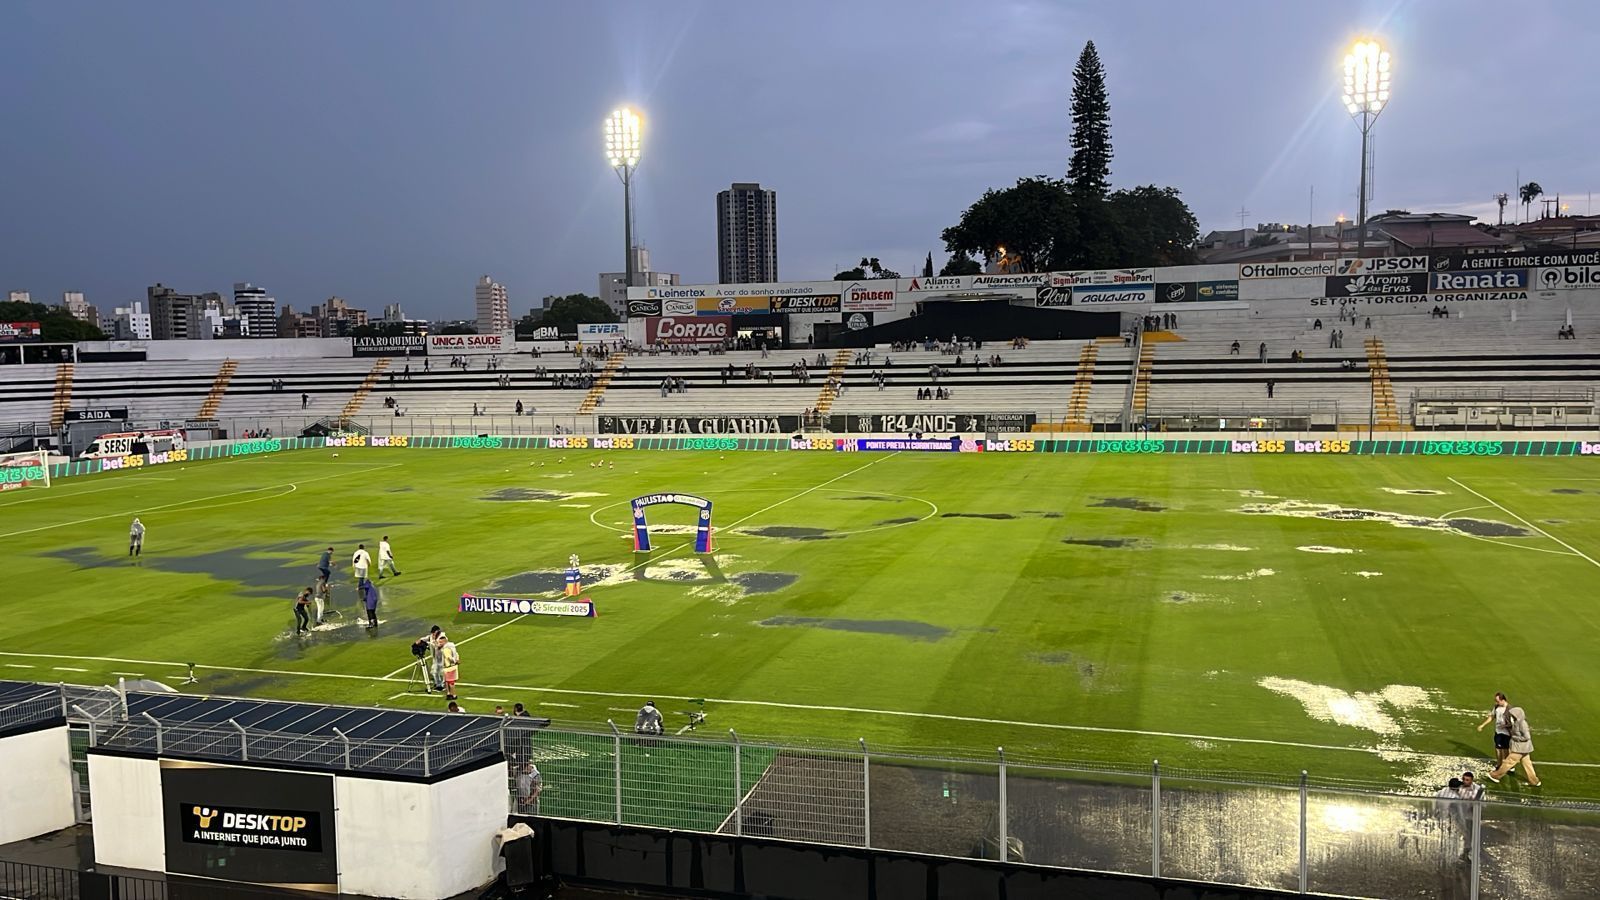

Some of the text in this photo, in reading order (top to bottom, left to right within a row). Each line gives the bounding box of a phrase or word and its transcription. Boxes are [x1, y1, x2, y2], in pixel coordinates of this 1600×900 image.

[1366, 256, 1426, 271] JPSOM
[1462, 260, 1468, 268] A
[1472, 258, 1505, 267] GENTE
[1508, 256, 1540, 266] TORCE
[1543, 255, 1568, 265] COM
[1241, 263, 1335, 277] Oftalmocenter
[924, 277, 960, 286] Alianza
[1365, 275, 1409, 285] Aroma
[1435, 271, 1521, 290] Renata
[659, 289, 705, 298] Leinertex
[751, 288, 774, 296] sonho
[777, 286, 813, 295] realizado
[1382, 283, 1412, 293] Ervas
[788, 296, 838, 307] DESKTOP
[851, 291, 894, 301] DALBEM
[1434, 292, 1528, 302] ORGANIZADA
[588, 325, 619, 334] EVER
[657, 317, 728, 337] CORTAG
[698, 418, 781, 434] GUARDA
[880, 415, 956, 432] 124 ANOS
[233, 438, 281, 456] bet365
[326, 436, 366, 447] bet365
[371, 436, 408, 447] bet365
[453, 435, 503, 448] bet365
[549, 437, 588, 449] bet365
[593, 437, 634, 449] bet365
[684, 437, 738, 450] bet365
[790, 438, 834, 450] bet365
[866, 441, 886, 449] PONTE
[986, 439, 1035, 452] bet365
[1097, 439, 1164, 453] bet365
[1231, 440, 1286, 453] bet365
[1294, 440, 1350, 453] bet365
[1423, 440, 1502, 455] bet365
[102, 454, 144, 471] bet365
[149, 449, 187, 465] bet365
[542, 603, 569, 612] Sicredi
[570, 605, 588, 613] 2025
[223, 812, 307, 832] DESKTOP
[194, 830, 307, 847] A INTERNET QUE JOGA JUNTO
